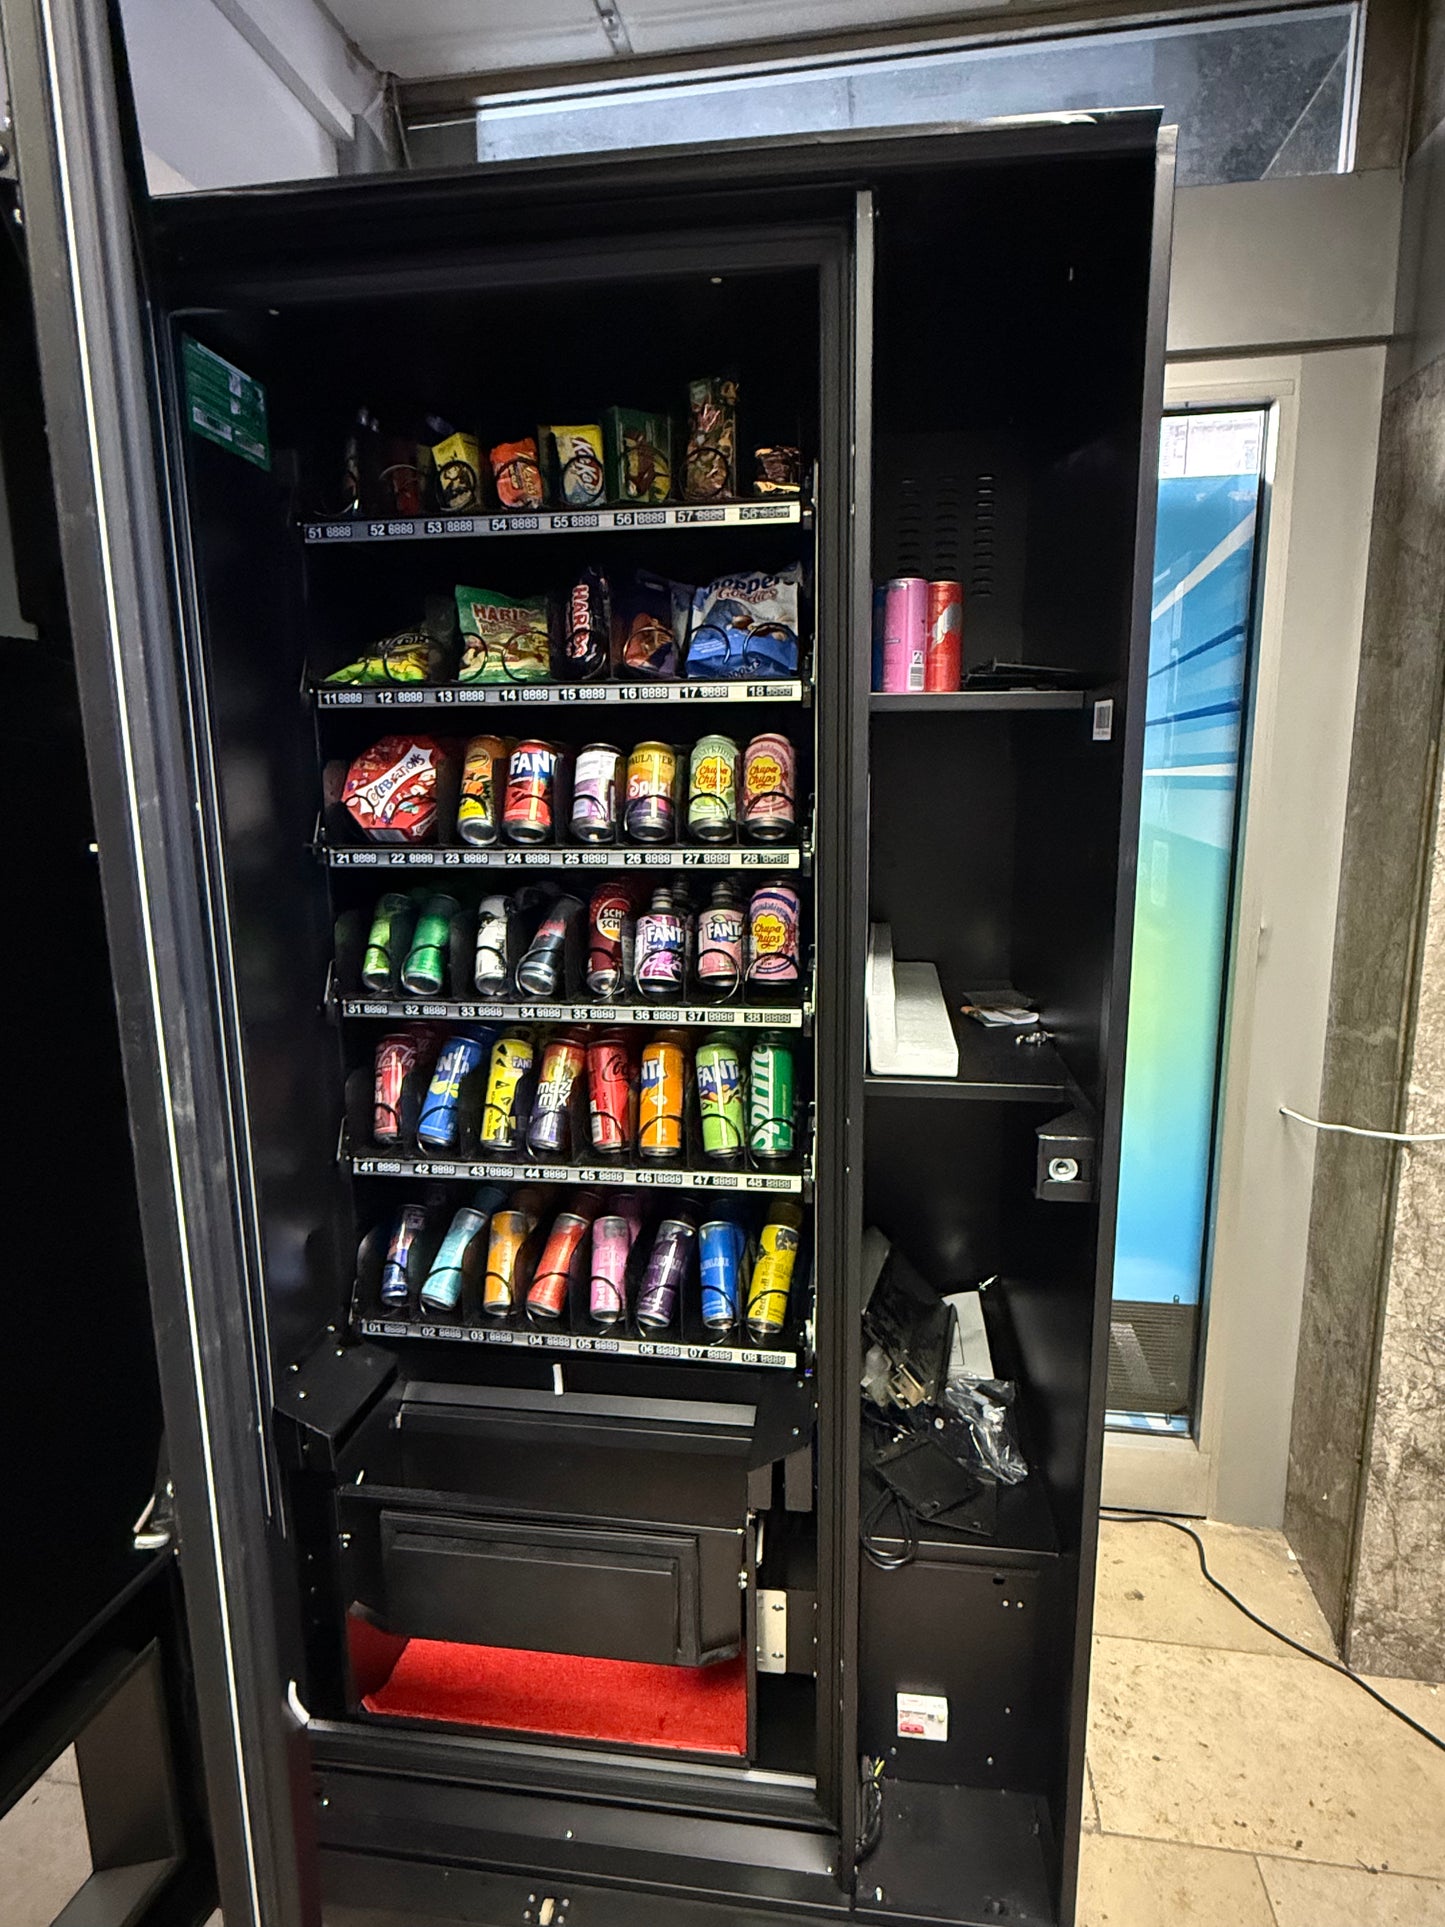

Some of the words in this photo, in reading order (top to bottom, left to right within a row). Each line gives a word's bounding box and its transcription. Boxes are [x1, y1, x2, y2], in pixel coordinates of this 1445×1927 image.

[617, 514, 632, 524] 56
[677, 511, 692, 522] 57
[492, 519, 507, 529] 54
[554, 517, 568, 528] 55
[309, 528, 322, 538] 51
[370, 525, 384, 535] 52
[427, 523, 442, 533] 53
[472, 603, 532, 622] HARI
[572, 585, 590, 658] HARBO
[438, 692, 452, 701] 13
[501, 691, 516, 700] 14
[561, 689, 576, 699] 15
[621, 688, 636, 698] 16
[682, 687, 697, 697] 17
[749, 687, 764, 696] 18
[323, 693, 337, 704] 11
[377, 693, 392, 703] 12
[748, 766, 778, 776] Chupa
[748, 775, 776, 788] Chups
[337, 854, 349, 864] 21
[391, 854, 405, 864] 22
[445, 854, 459, 864] 23
[507, 854, 522, 864] 24
[565, 854, 579, 864] 25
[627, 854, 641, 864] 26
[685, 854, 699, 864] 27
[743, 854, 758, 864] 28
[603, 909, 625, 919] SCH
[647, 926, 683, 941] FANT
[754, 923, 782, 934] Chupa
[349, 1005, 361, 1013] 31
[405, 1006, 419, 1014] 32
[461, 1007, 475, 1016] 33
[521, 1008, 534, 1018] 34
[573, 1009, 587, 1019] 35
[635, 1010, 649, 1020] 36
[687, 1012, 702, 1021] 37
[746, 1013, 760, 1022] 38
[751, 1045, 779, 1149] Sprite
[361, 1163, 373, 1171] 41
[415, 1165, 429, 1173] 42
[470, 1166, 484, 1175] 43
[526, 1168, 539, 1177] 44
[581, 1171, 595, 1180] 45
[637, 1172, 651, 1182] 46
[695, 1175, 708, 1184] 47
[748, 1178, 762, 1187] 48
[369, 1324, 381, 1332] 01
[422, 1328, 435, 1336] 02
[471, 1331, 484, 1340] 03
[530, 1335, 542, 1344] 04
[578, 1339, 591, 1349] 05
[641, 1345, 654, 1354] 06
[690, 1349, 703, 1357] 07
[744, 1353, 757, 1362] 08
